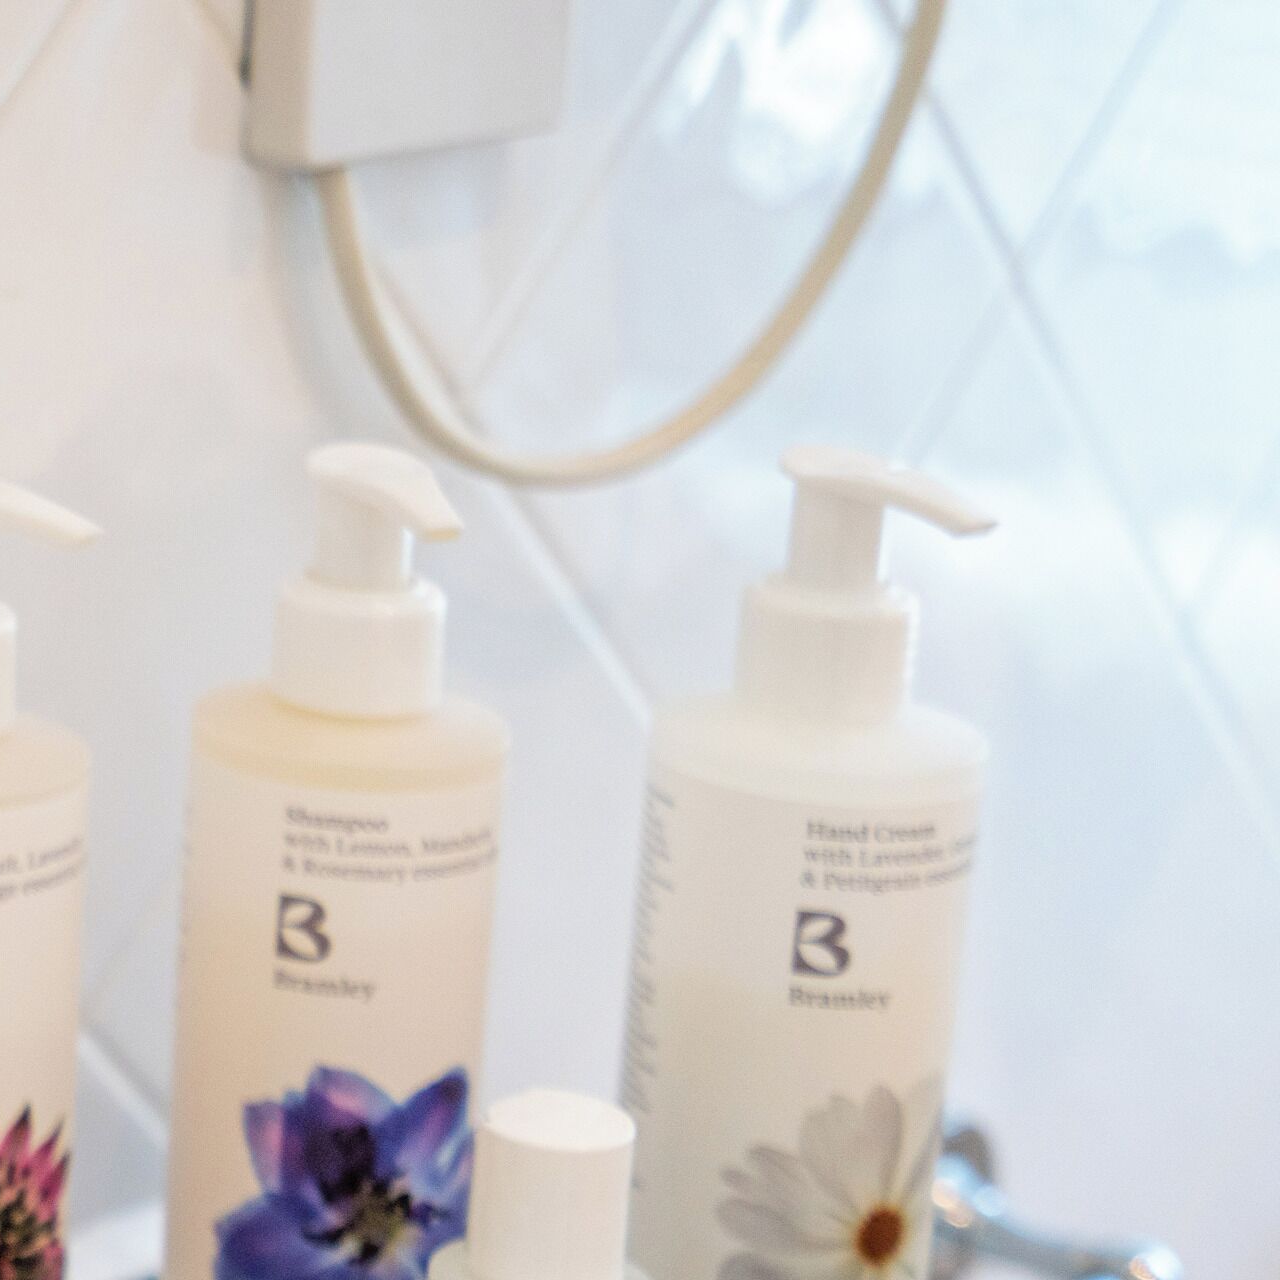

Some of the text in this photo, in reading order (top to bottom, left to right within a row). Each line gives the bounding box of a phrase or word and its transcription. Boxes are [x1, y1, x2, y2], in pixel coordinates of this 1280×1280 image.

[286, 807, 389, 833] Shampoo
[806, 820, 868, 843] Hand
[873, 824, 936, 844] Cream
[284, 832, 330, 851] with
[804, 848, 851, 867] with
[276, 892, 333, 964] B
[791, 910, 851, 980] B
[273, 969, 377, 1006] Bramley
[789, 986, 893, 1015] Bramley
